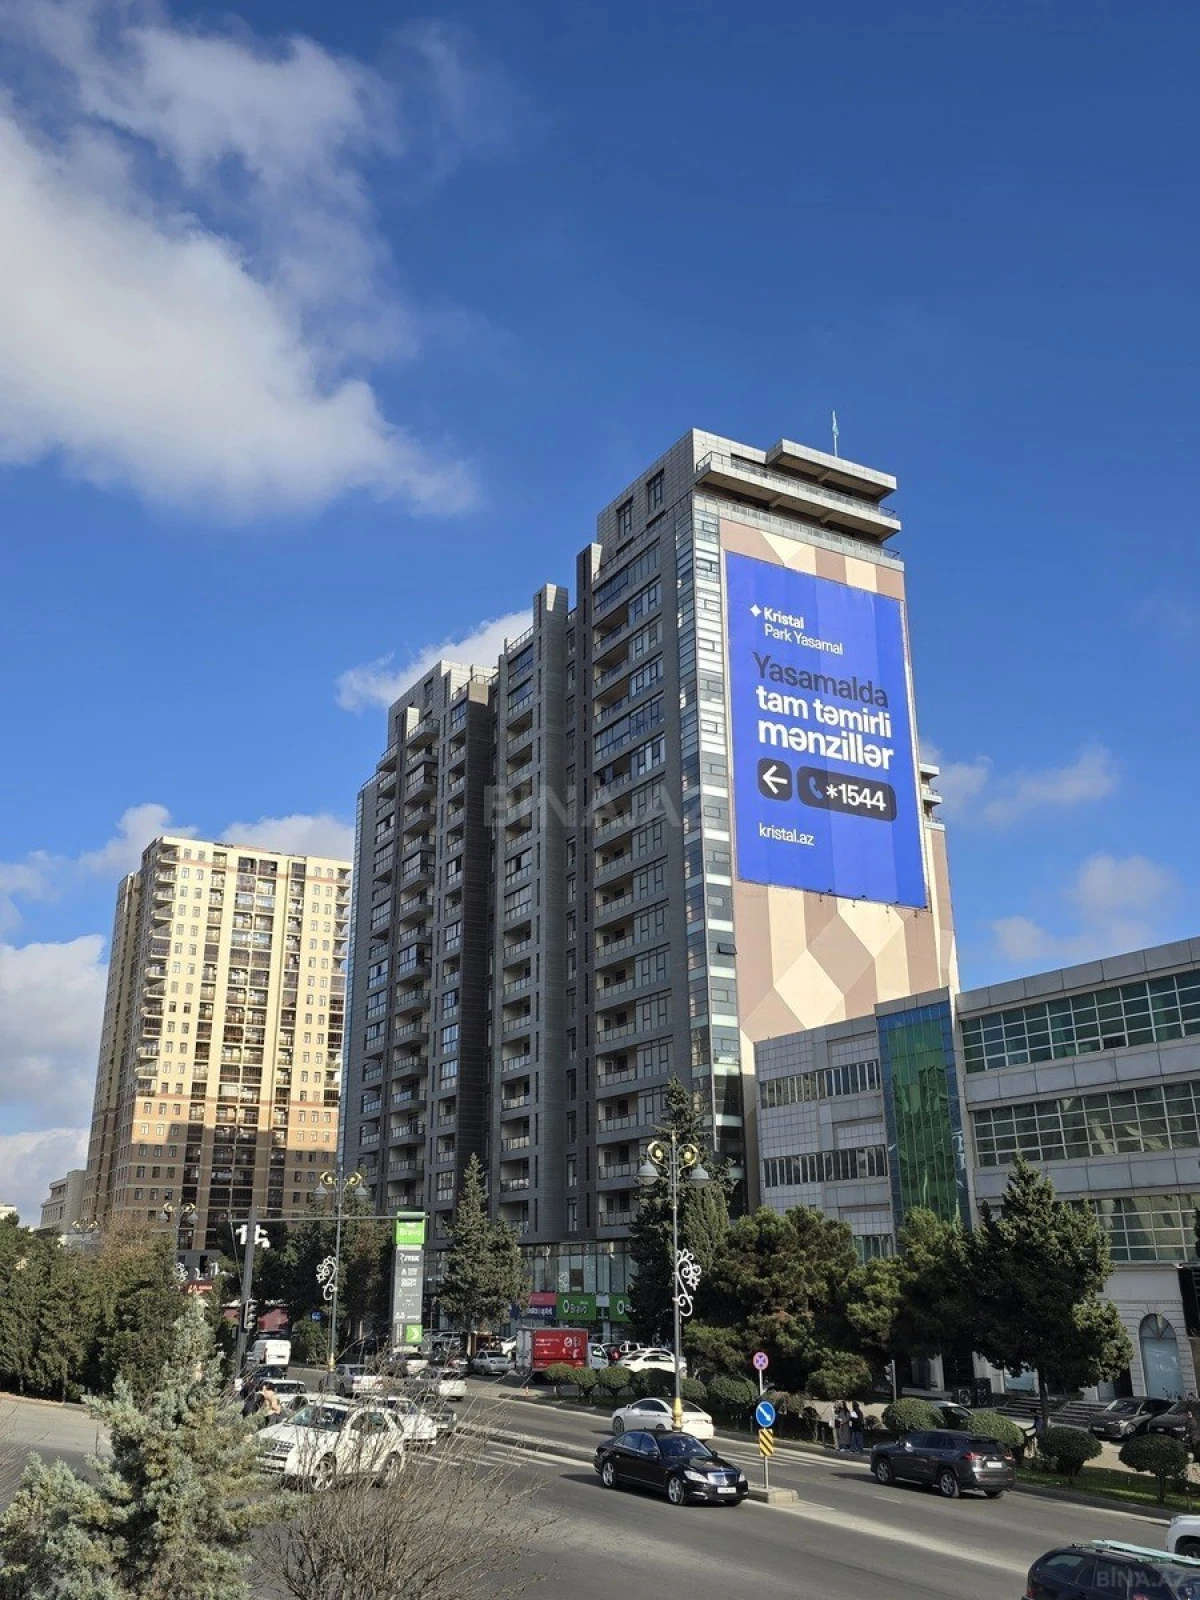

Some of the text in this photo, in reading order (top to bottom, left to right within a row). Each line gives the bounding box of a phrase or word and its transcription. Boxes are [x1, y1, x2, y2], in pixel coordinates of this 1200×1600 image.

[763, 606, 804, 629] Kristal
[764, 623, 843, 655] Park Yasamal
[753, 651, 888, 708] Yasamalda
[756, 685, 892, 738] tam təmirli
[758, 719, 894, 770] mənzillər
[759, 822, 815, 846] kristal.az
